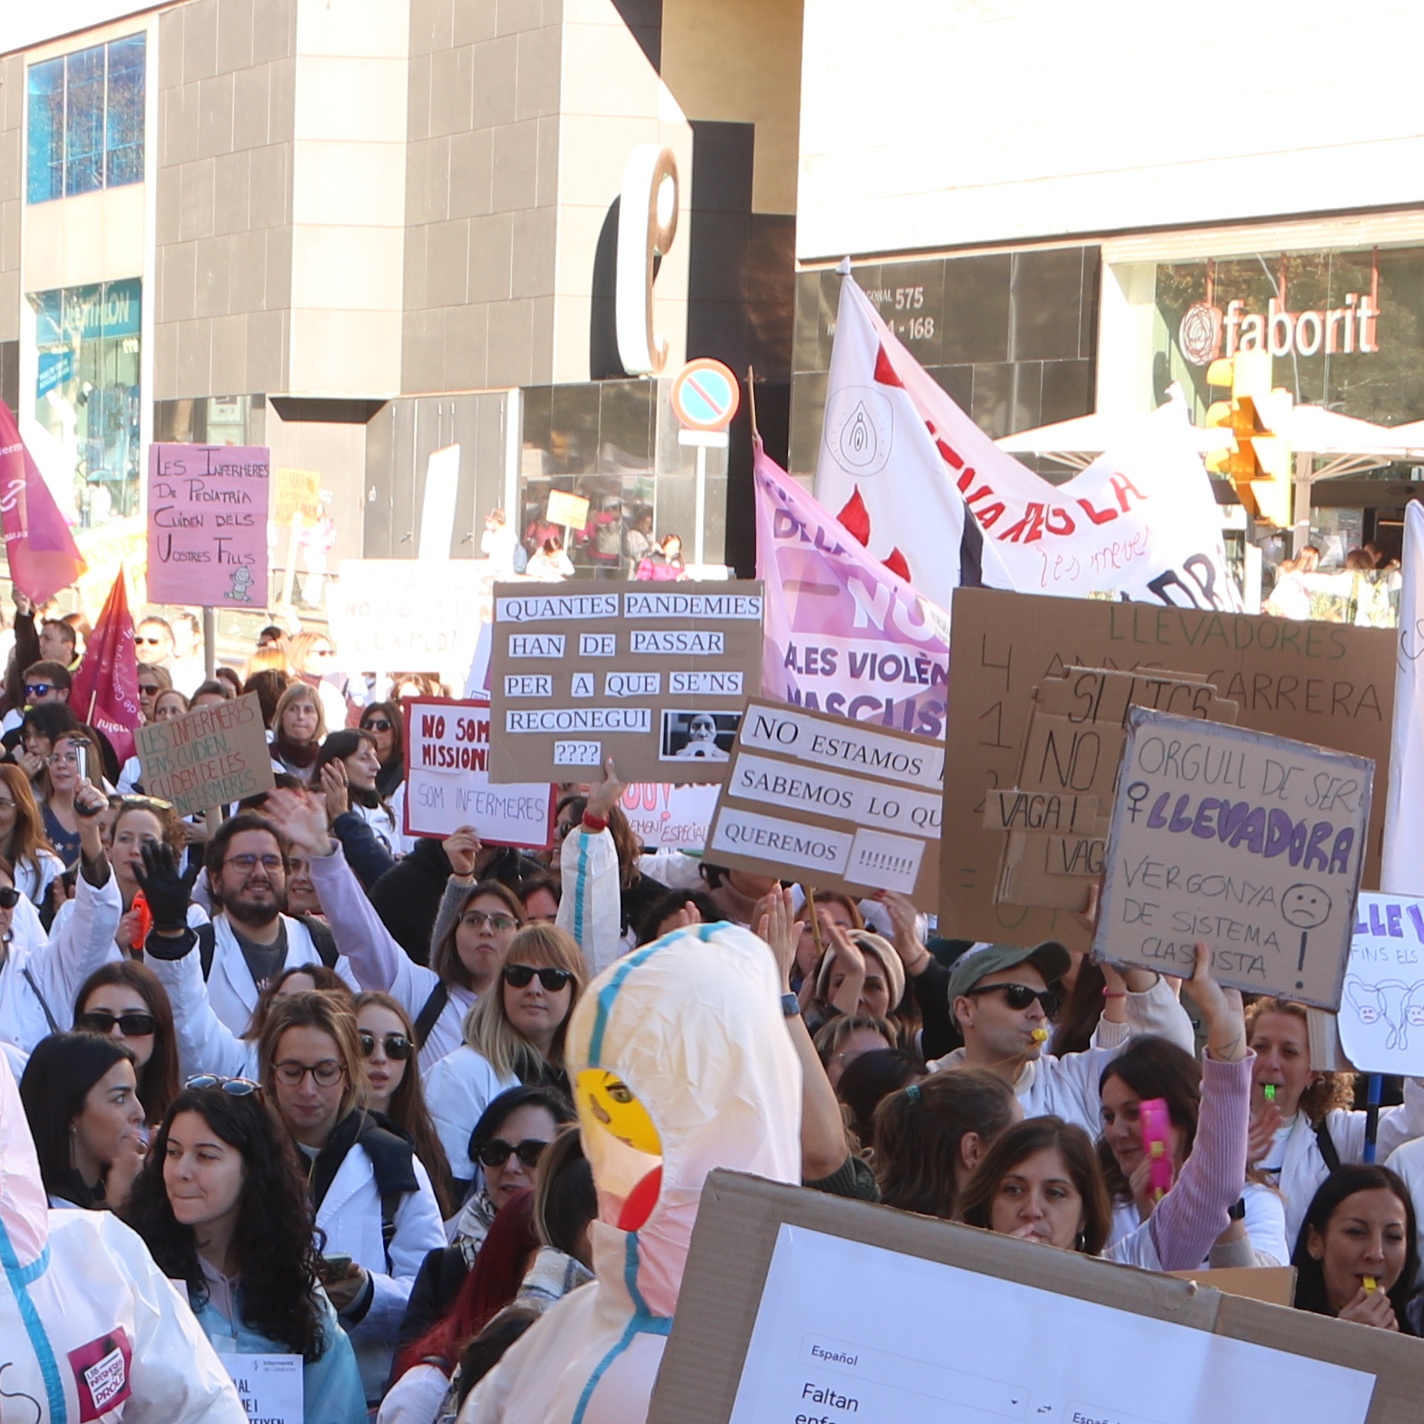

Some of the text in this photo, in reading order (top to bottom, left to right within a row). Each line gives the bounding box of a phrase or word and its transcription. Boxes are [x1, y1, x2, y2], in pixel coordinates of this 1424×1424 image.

[895, 286, 924, 310] 575
[908, 317, 935, 339] 168
[1223, 296, 1376, 358] faborit
[215, 514, 255, 527] DELS
[505, 595, 761, 620] QUANTES PANDEMIES
[511, 631, 723, 656] HAN DE PASSAR
[1109, 606, 1348, 661] LLEVADORES
[506, 676, 550, 695] PER
[574, 677, 592, 695] A
[607, 673, 657, 697] QUE
[1067, 672, 1107, 725] SI
[141, 699, 255, 755] LES INFERMERES
[421, 714, 446, 739] NO
[508, 710, 650, 732] RECONEGUI
[556, 742, 600, 764] ????
[752, 715, 924, 776] NO ESTAMOS
[219, 752, 246, 777] LES
[1039, 729, 1102, 794] NO
[1138, 736, 1360, 815] ORGULL DE SER
[417, 783, 545, 823] SOM INFERMERES
[740, 768, 900, 821] SABEMOS LO
[724, 823, 838, 863] QUEREMOS
[1146, 790, 1356, 875] LLEVADORA
[1122, 855, 1276, 909] VERGONYA
[1122, 898, 1154, 927] DE
[1396, 950, 1419, 965] ELS
[810, 1344, 859, 1368] Español
[801, 1382, 860, 1414] Faltan
